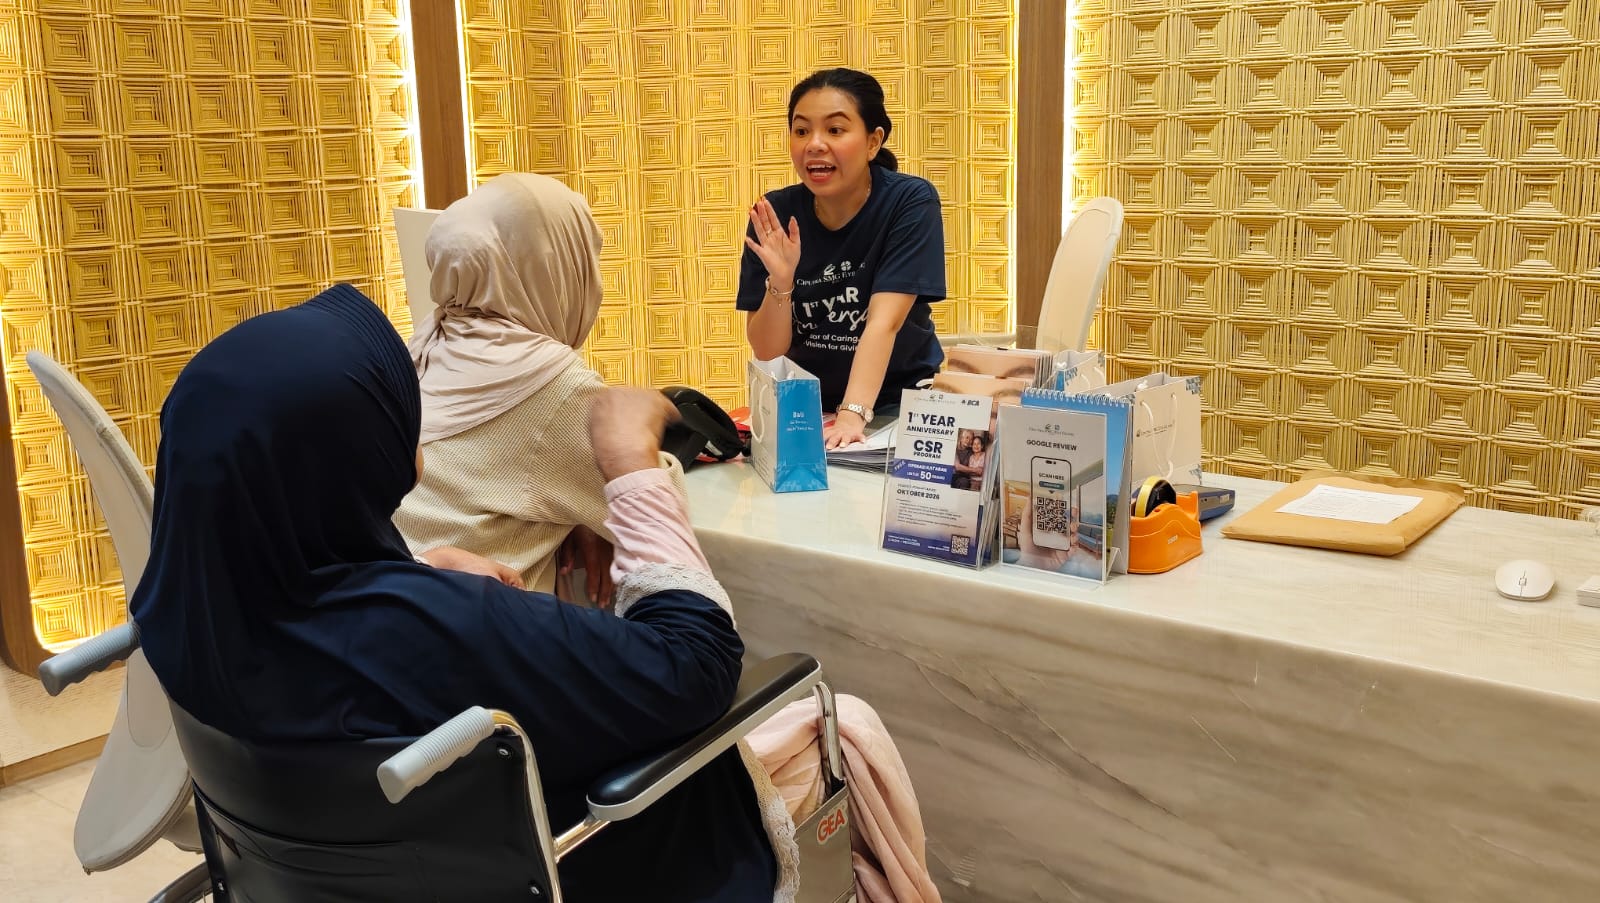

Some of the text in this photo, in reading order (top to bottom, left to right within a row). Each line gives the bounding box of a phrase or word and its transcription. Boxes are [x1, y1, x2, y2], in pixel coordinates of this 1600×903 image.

[822, 333, 831, 341] of
[828, 343, 839, 351] for
[921, 413, 956, 428] YEAR
[906, 425, 954, 436] ANNIVERSARY
[913, 439, 943, 454] CSR
[1026, 439, 1078, 451] GOOGLE REVIEW
[913, 451, 942, 459] PROGRAM
[919, 470, 932, 480] 50
[896, 488, 925, 498] OKTOBER
[817, 808, 846, 842] GEA
